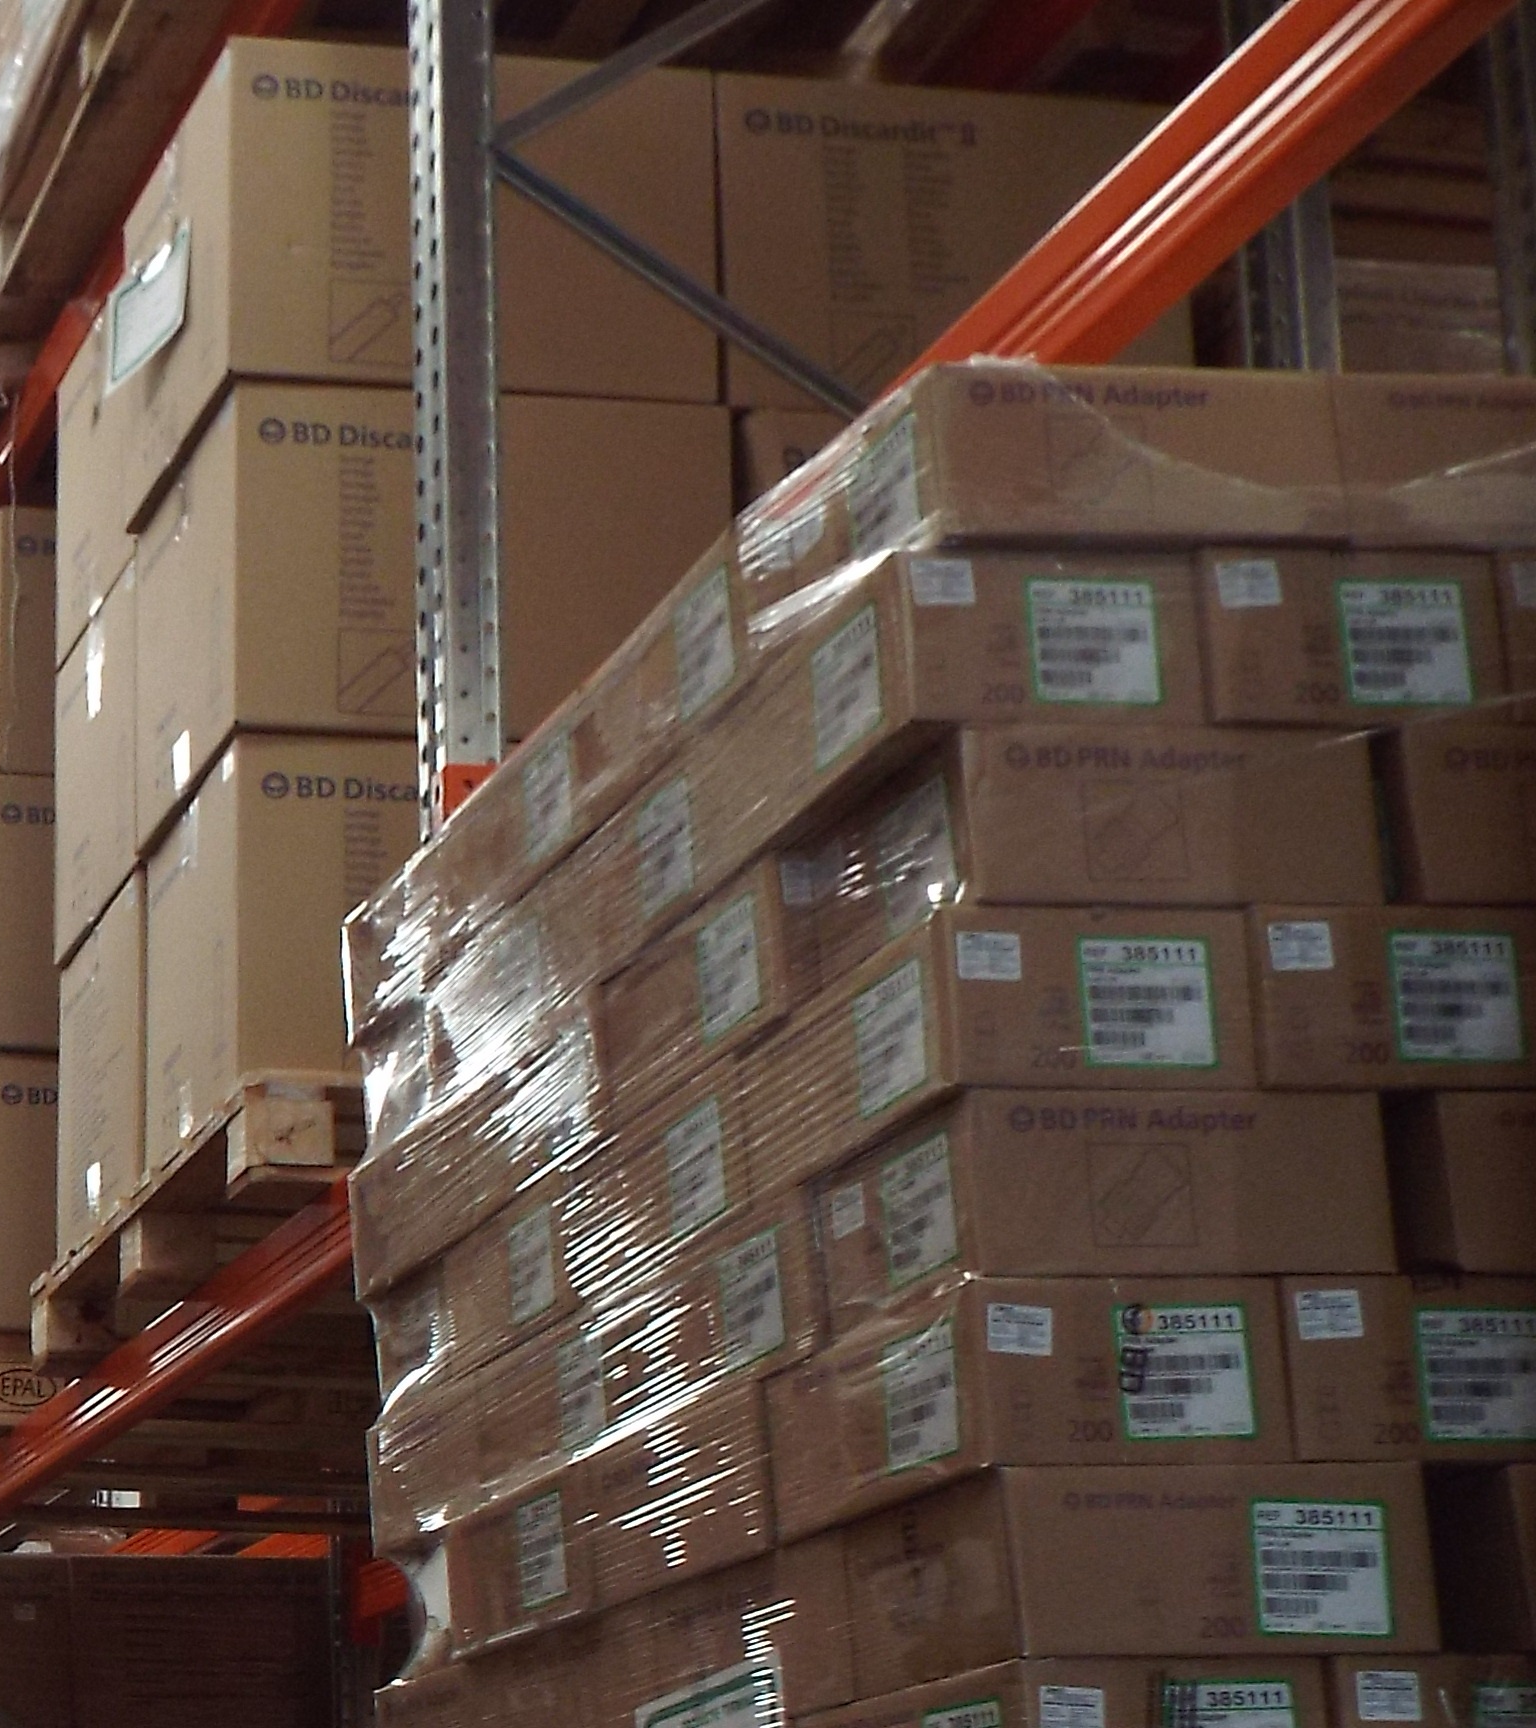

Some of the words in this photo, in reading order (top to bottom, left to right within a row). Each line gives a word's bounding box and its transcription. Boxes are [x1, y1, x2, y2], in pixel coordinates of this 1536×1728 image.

[285, 78, 323, 99] BD
[777, 111, 814, 134] BD
[1103, 383, 1209, 410] Adapter
[295, 424, 332, 445] BD
[1068, 588, 1145, 607] 385111
[1035, 747, 1071, 768] BD
[1077, 747, 1131, 768] PRN
[1141, 748, 1247, 772] Adapter
[296, 776, 336, 799] BD
[1122, 945, 1197, 964] 385111
[27, 1085, 58, 1105] BD
[1040, 1109, 1076, 1131] BD
[1147, 1109, 1257, 1134] Adapter
[1157, 1313, 1236, 1332] 385111
[0, 1377, 46, 1399] EPAL
[1068, 1420, 1114, 1442] 200
[1295, 1508, 1373, 1526] 385111
[1206, 1690, 1285, 1708] 385111
